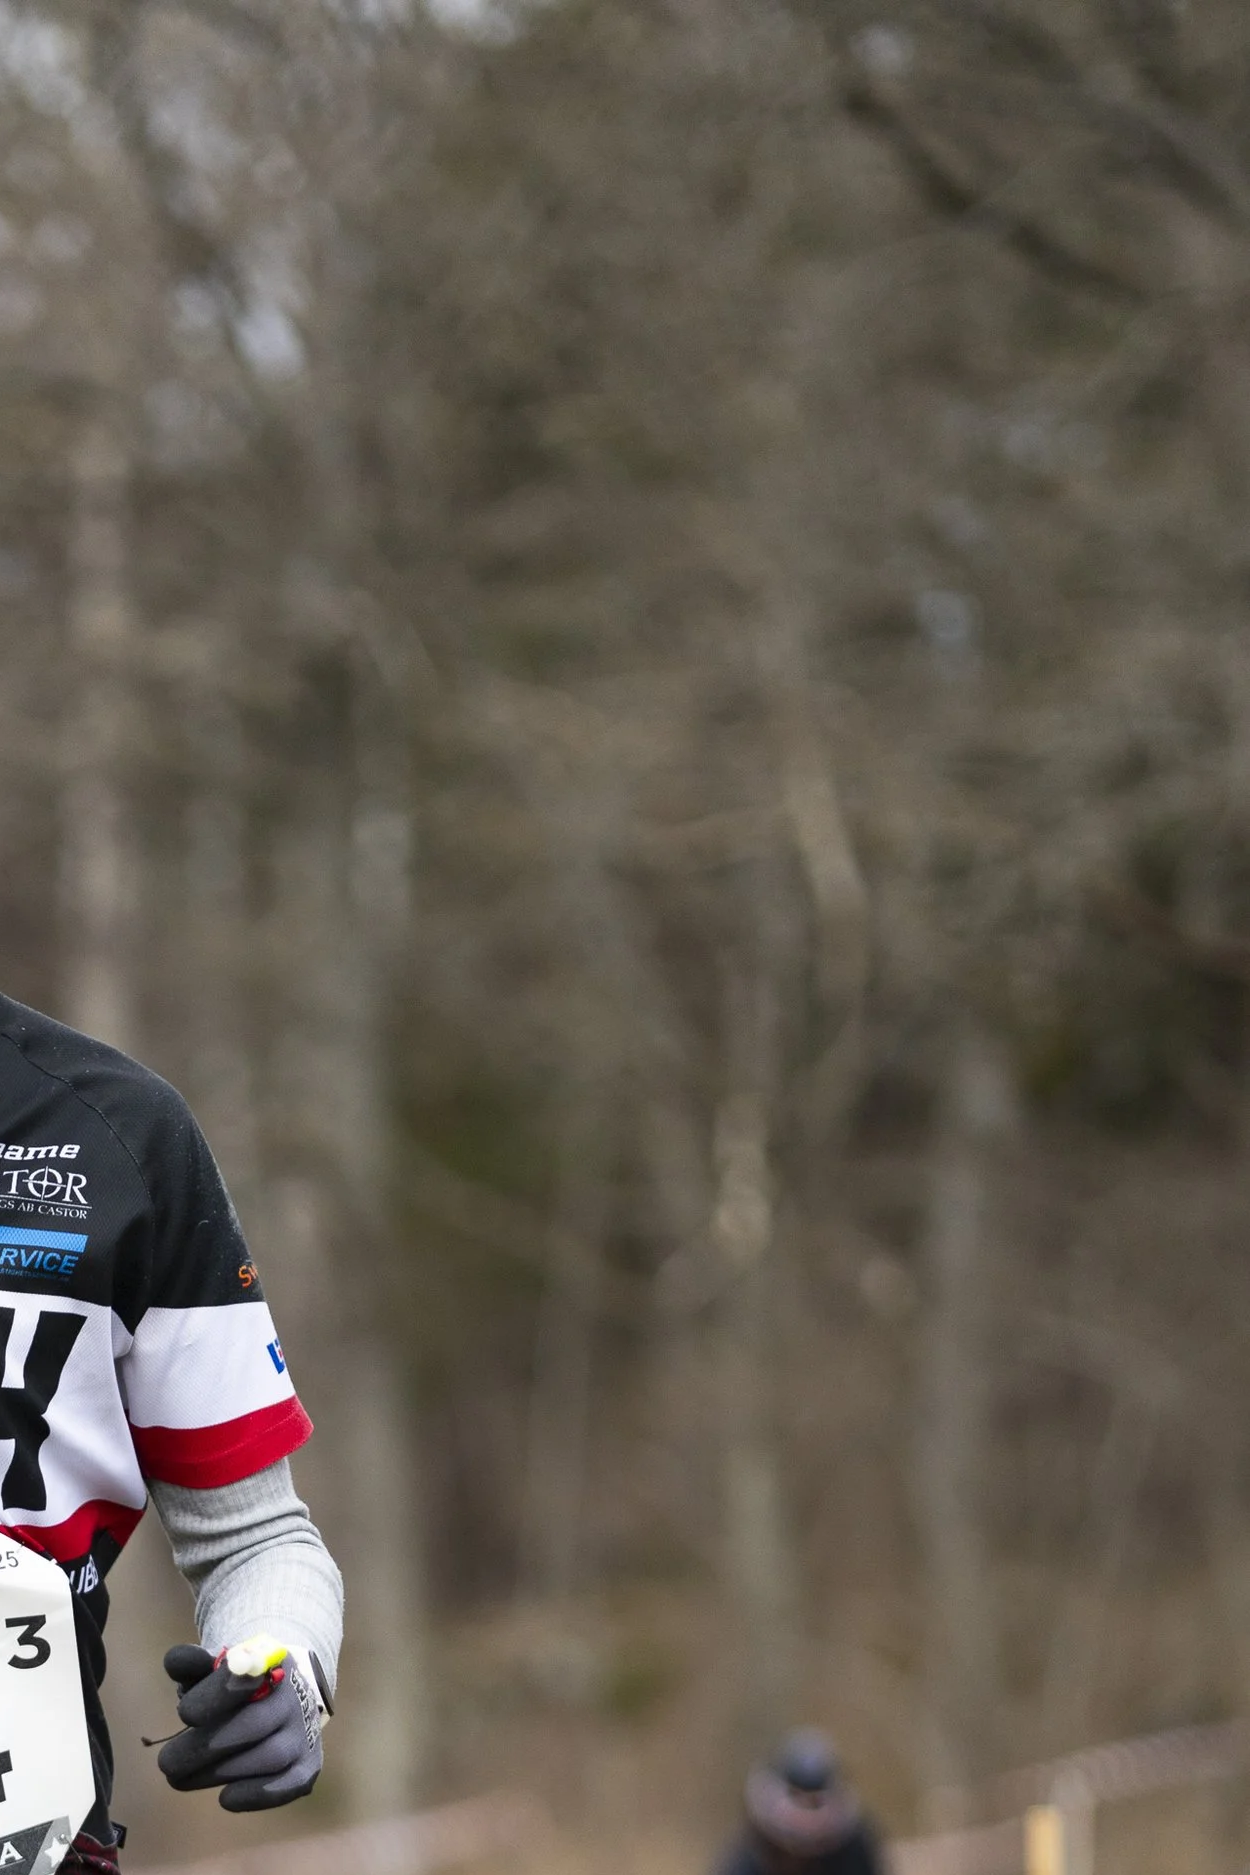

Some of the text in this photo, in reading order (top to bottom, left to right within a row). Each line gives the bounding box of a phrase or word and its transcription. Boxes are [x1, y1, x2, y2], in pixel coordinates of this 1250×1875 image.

[17, 1201, 35, 1213] AB
[37, 1204, 88, 1220] CASTOR
[5, 1614, 51, 1670] 3
